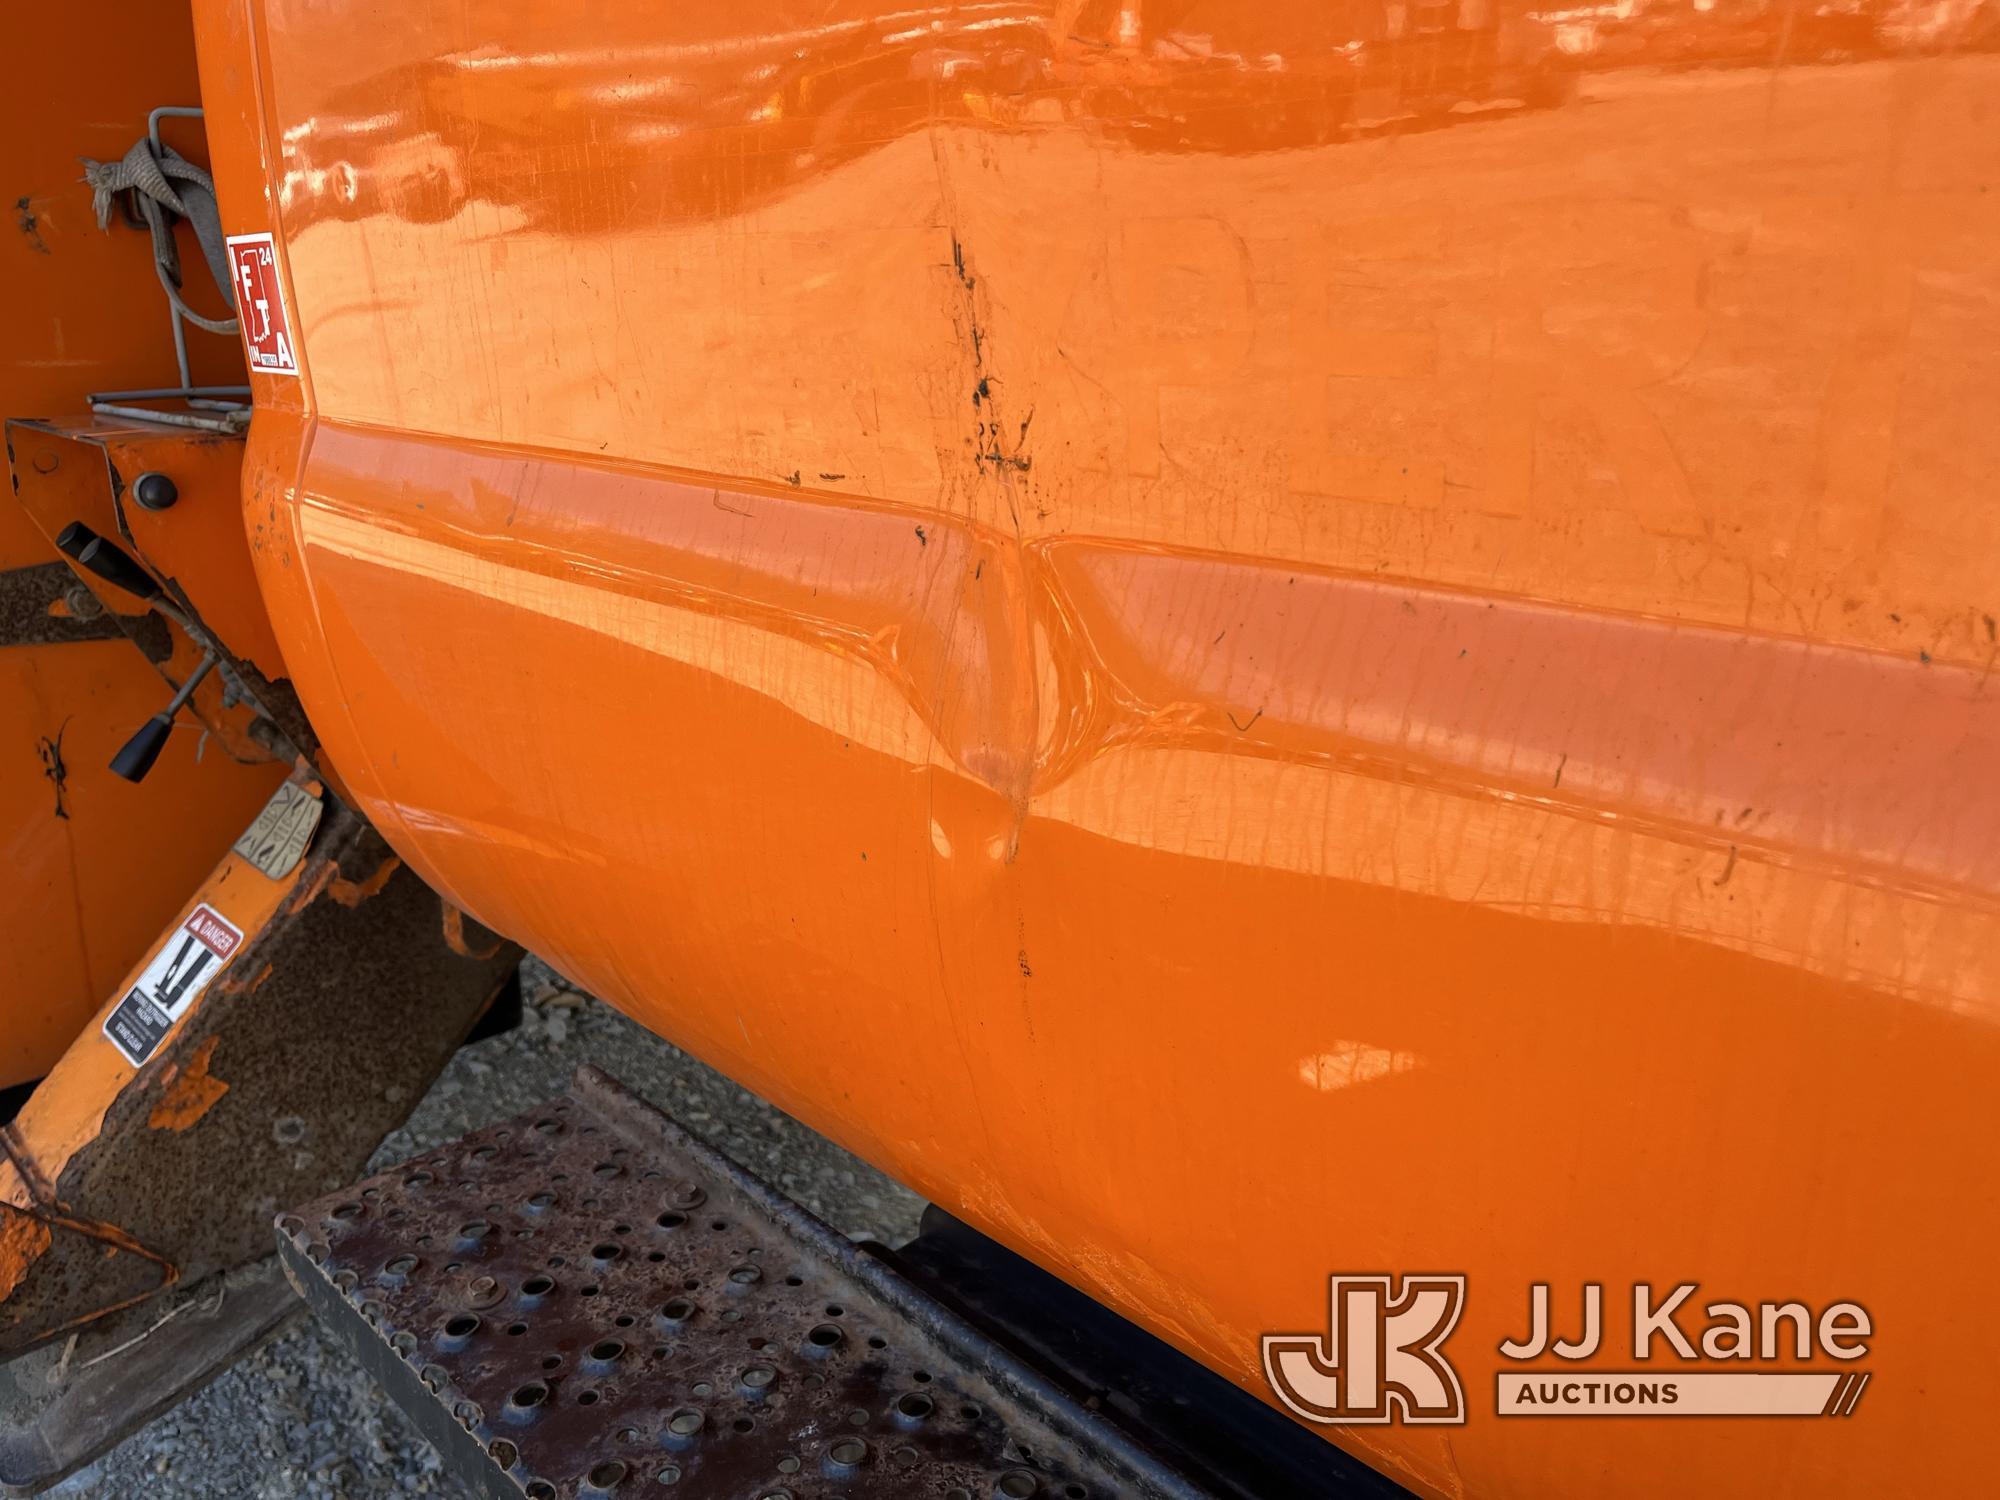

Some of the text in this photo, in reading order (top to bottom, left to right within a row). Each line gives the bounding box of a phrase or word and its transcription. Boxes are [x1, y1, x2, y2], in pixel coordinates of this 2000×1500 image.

[259, 247, 273, 266] 24
[249, 345, 261, 363] IN
[200, 920, 234, 954] DANGER
